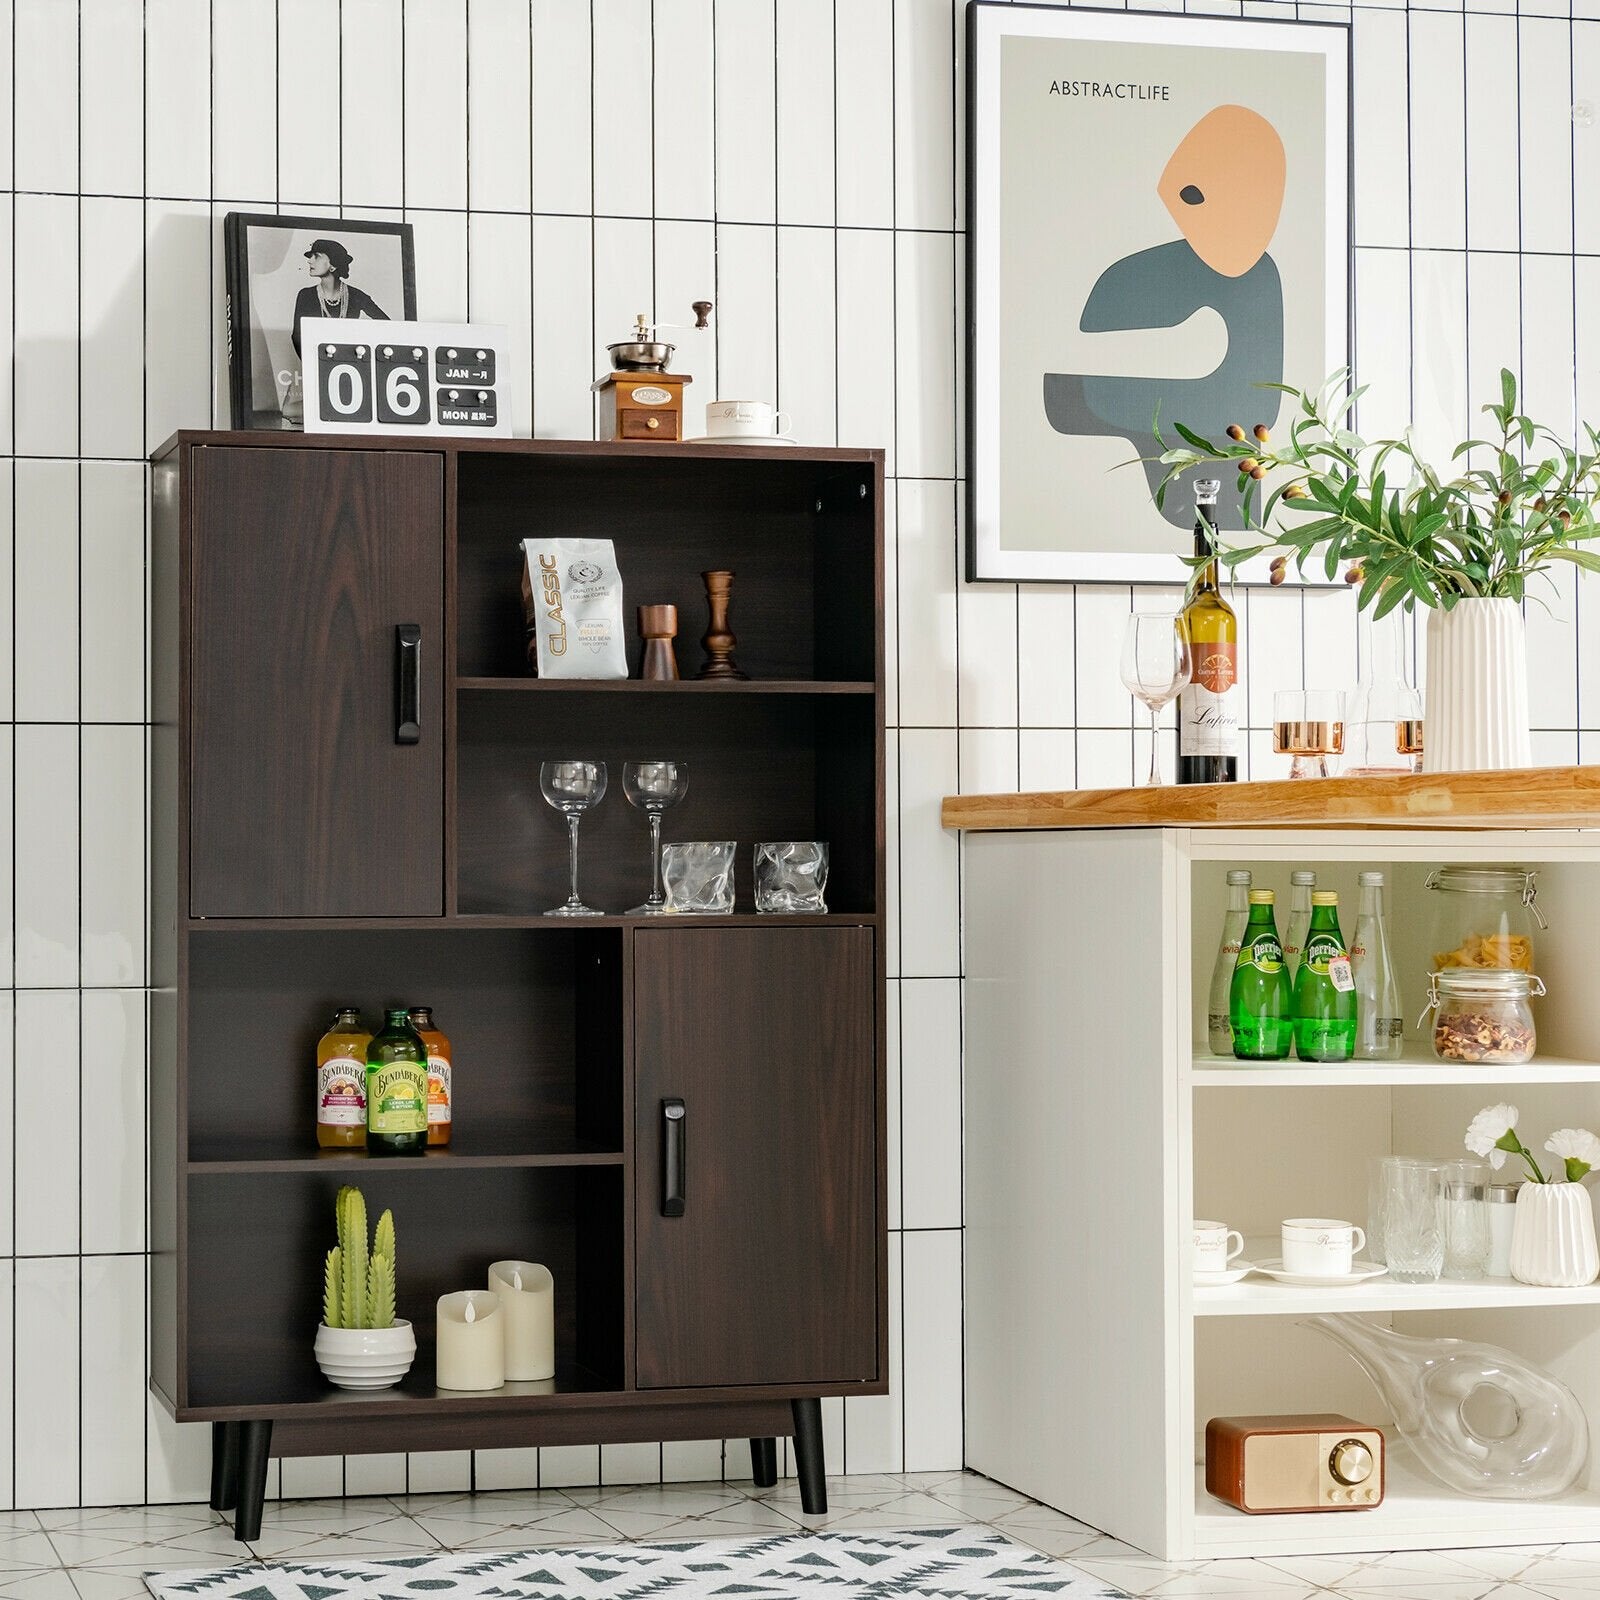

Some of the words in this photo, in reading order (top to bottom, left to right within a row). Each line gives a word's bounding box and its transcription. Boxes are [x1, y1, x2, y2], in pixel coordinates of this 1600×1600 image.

[1049, 80, 1169, 101] ABSTRACTLIFE
[445, 368, 469, 379] JAN
[472, 370, 488, 380] 一月
[442, 410, 468, 420] MON
[539, 554, 567, 657] CLASSIC
[1222, 945, 1241, 954] evia
[1309, 942, 1339, 965] perrier
